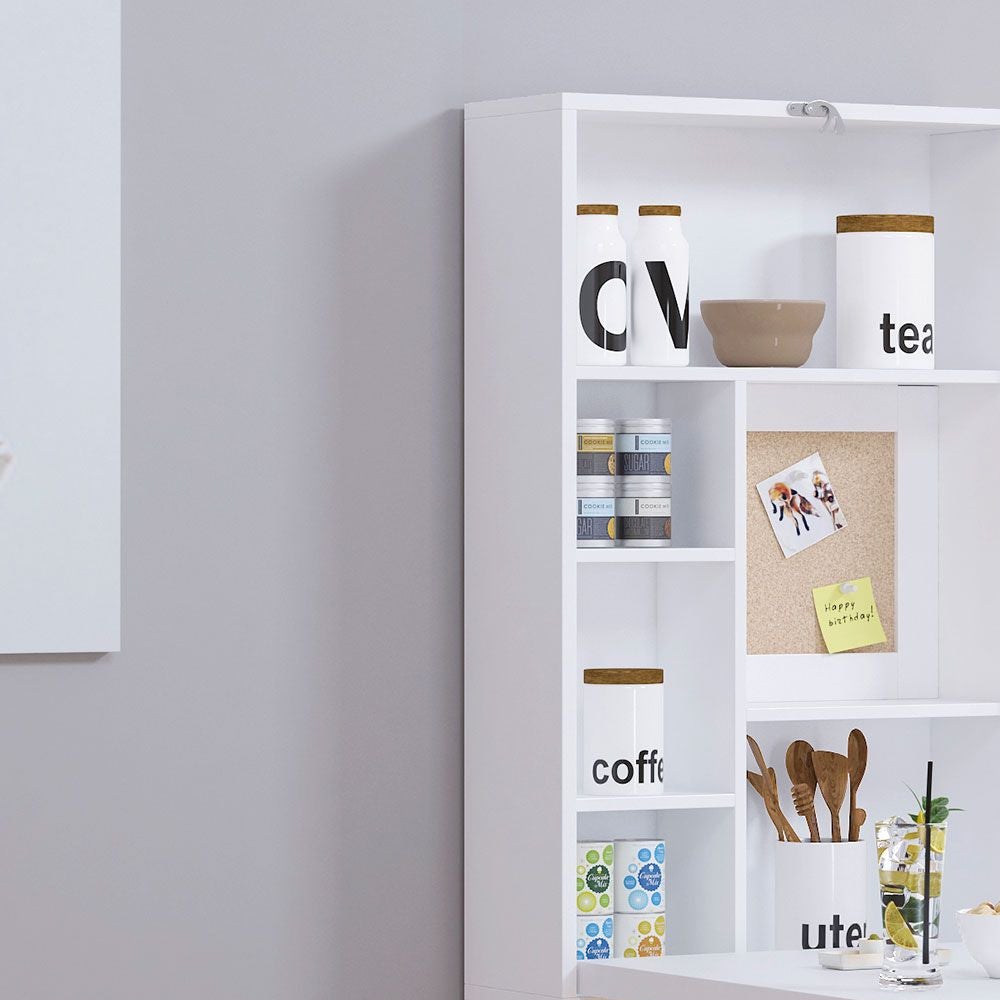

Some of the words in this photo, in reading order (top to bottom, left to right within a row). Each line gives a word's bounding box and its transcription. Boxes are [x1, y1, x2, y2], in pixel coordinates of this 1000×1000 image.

[644, 260, 690, 349] V
[880, 312, 934, 355] tea
[623, 453, 650, 471] SUGAR
[824, 601, 856, 613] Happy
[801, 914, 867, 950] ute
